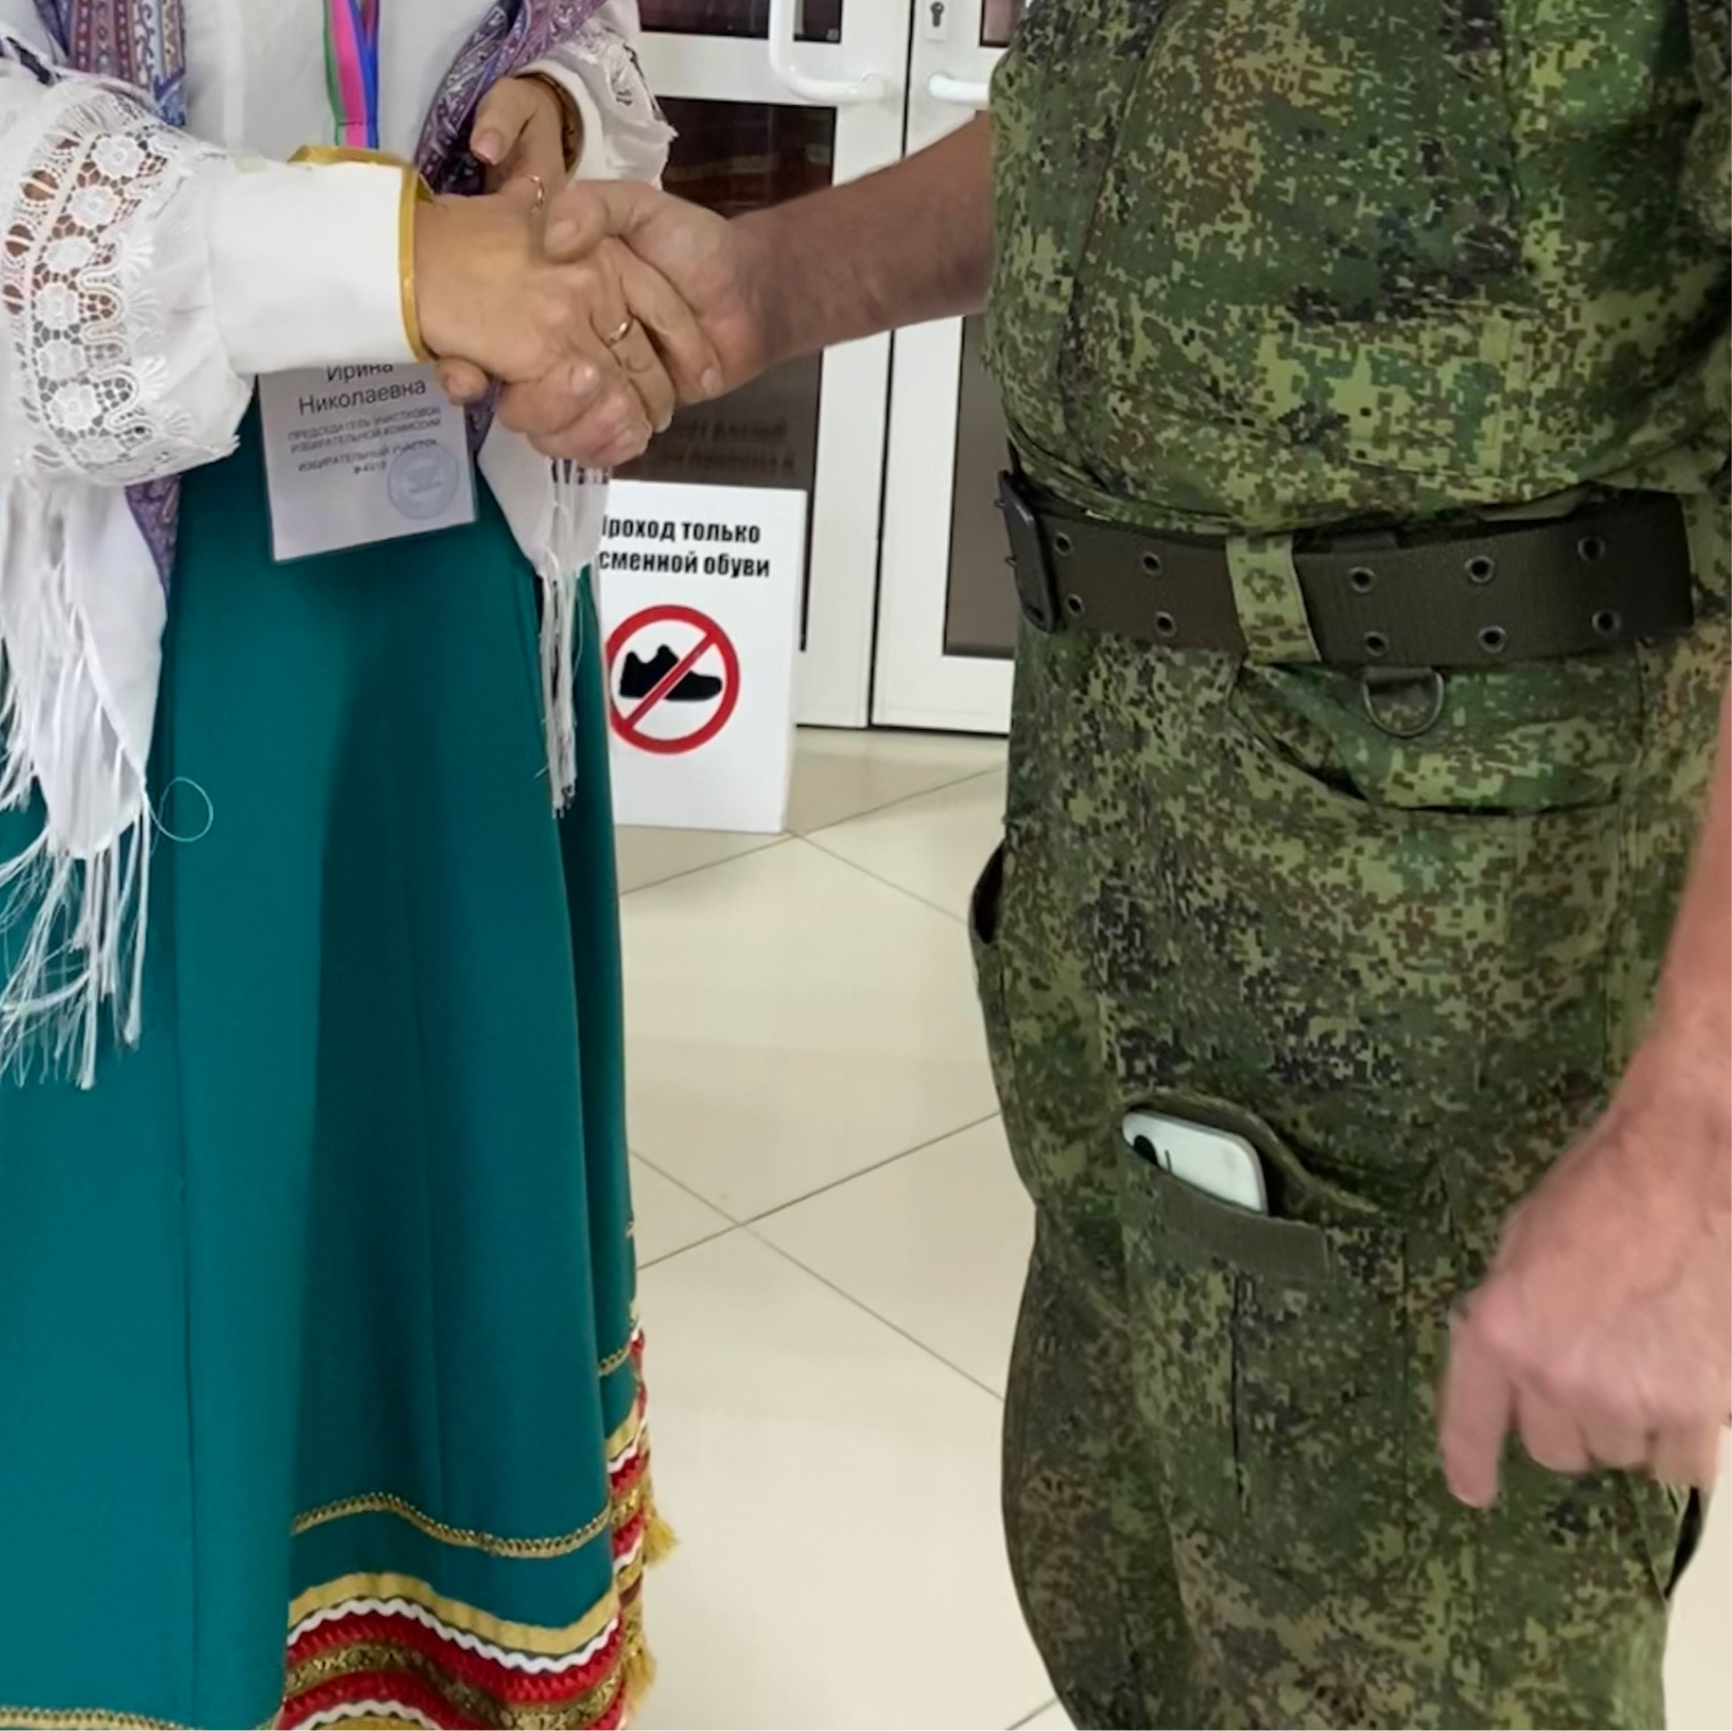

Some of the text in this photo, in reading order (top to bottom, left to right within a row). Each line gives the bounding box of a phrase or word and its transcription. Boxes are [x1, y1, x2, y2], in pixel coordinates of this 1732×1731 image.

[298, 379, 427, 416] Николаевна
[681, 521, 762, 545] только
[599, 550, 770, 579] сменной обуви
